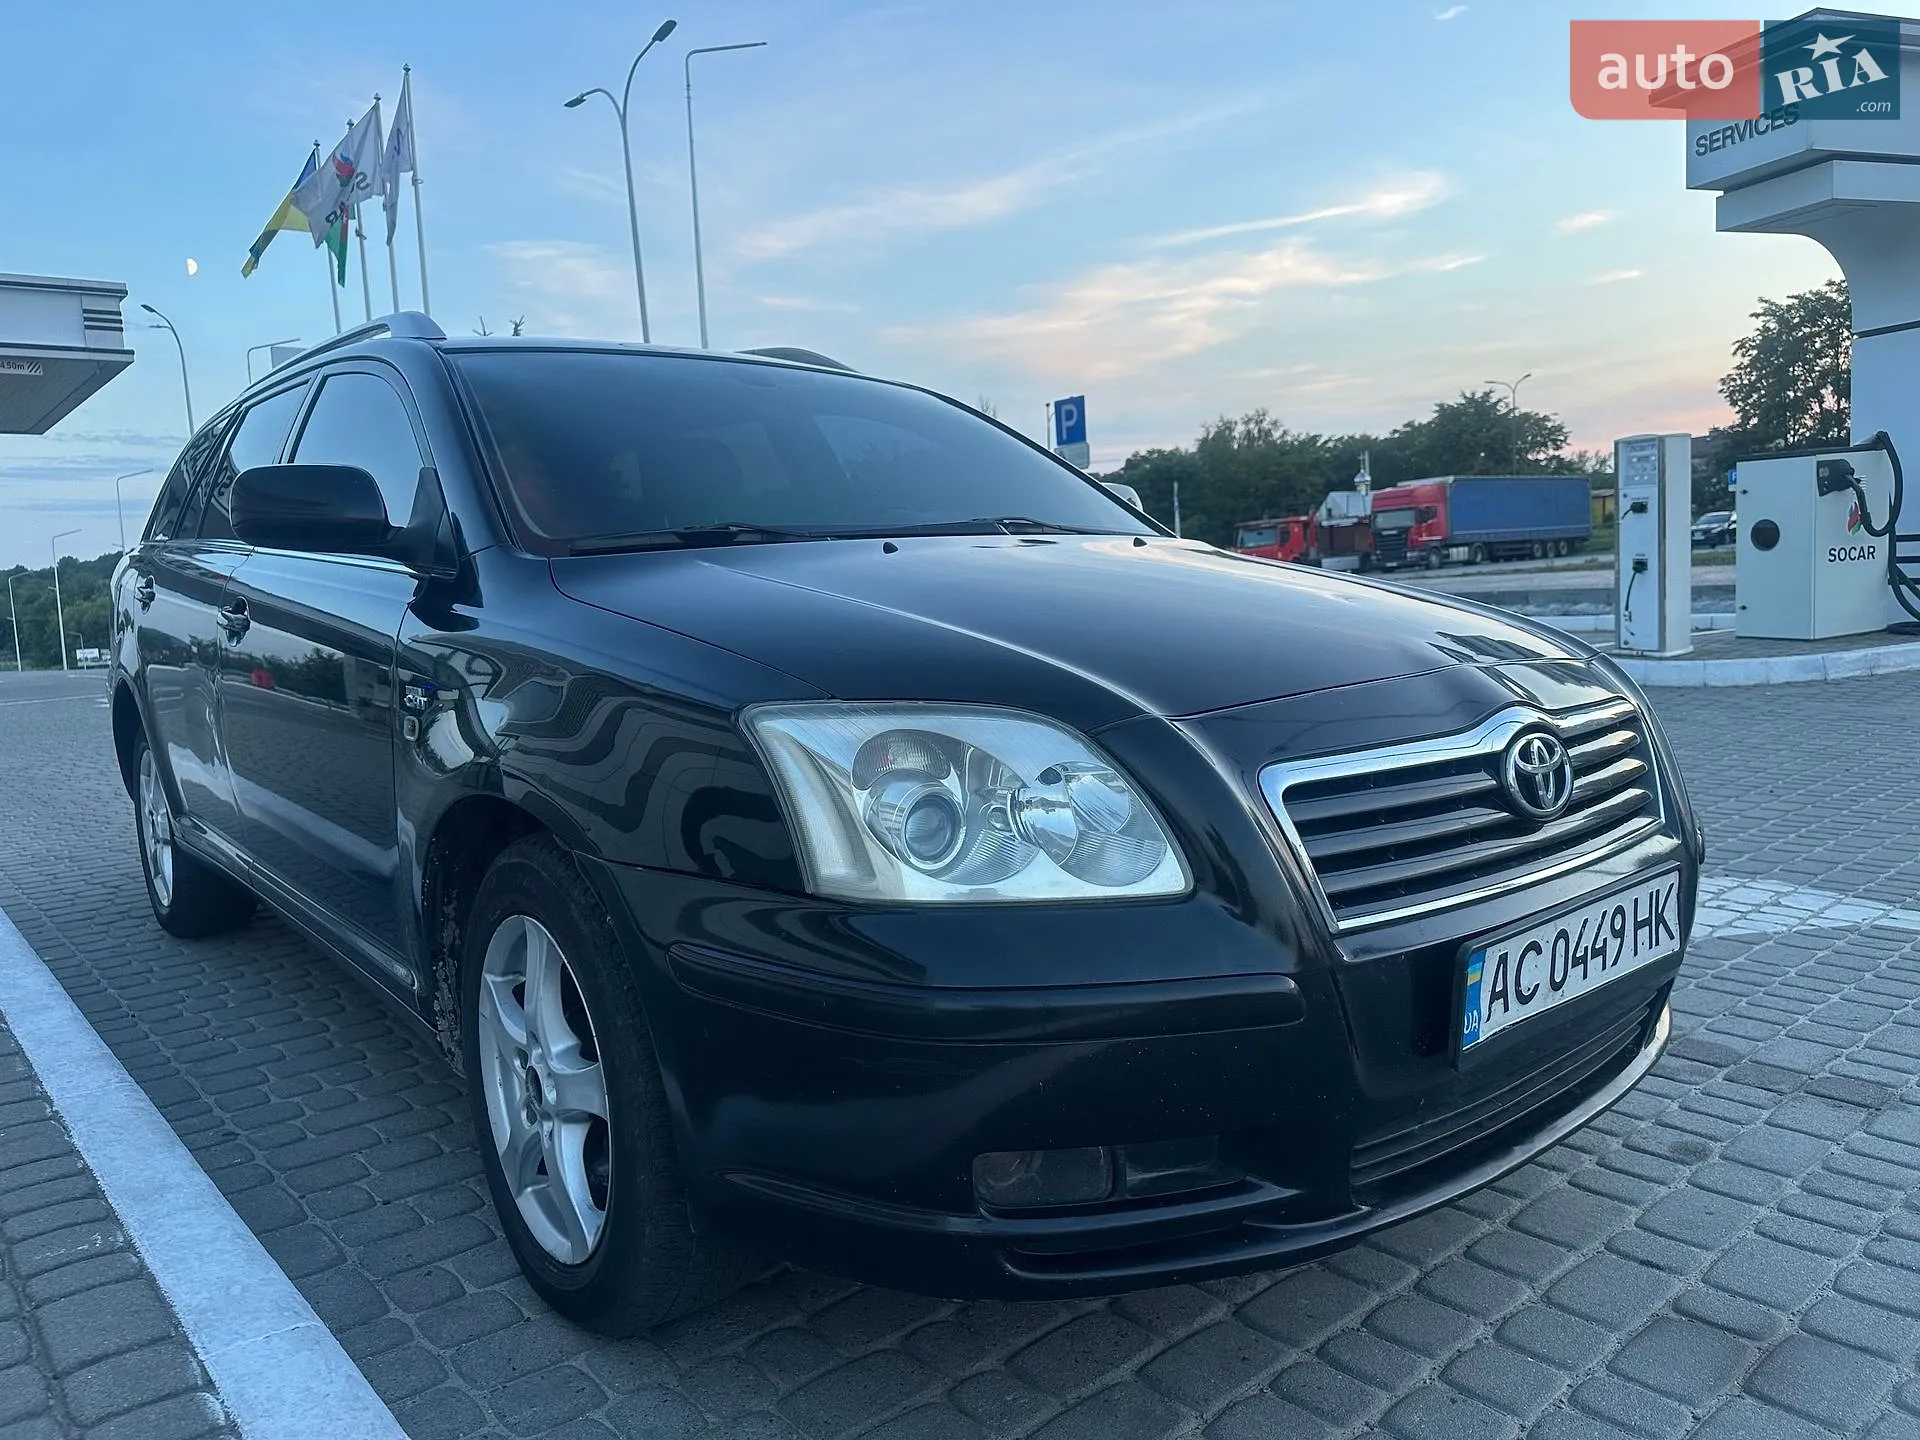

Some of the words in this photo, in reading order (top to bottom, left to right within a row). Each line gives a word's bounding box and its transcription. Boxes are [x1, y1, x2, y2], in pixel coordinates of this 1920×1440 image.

[1695, 103, 1801, 157] SERVICES
[1060, 403, 1078, 440] P
[1828, 545, 1876, 563] SOCAR
[1486, 940, 1543, 1023] AC
[1549, 904, 1627, 992] 0449
[1633, 882, 1675, 957] HK
[1464, 1010, 1479, 1034] UA
